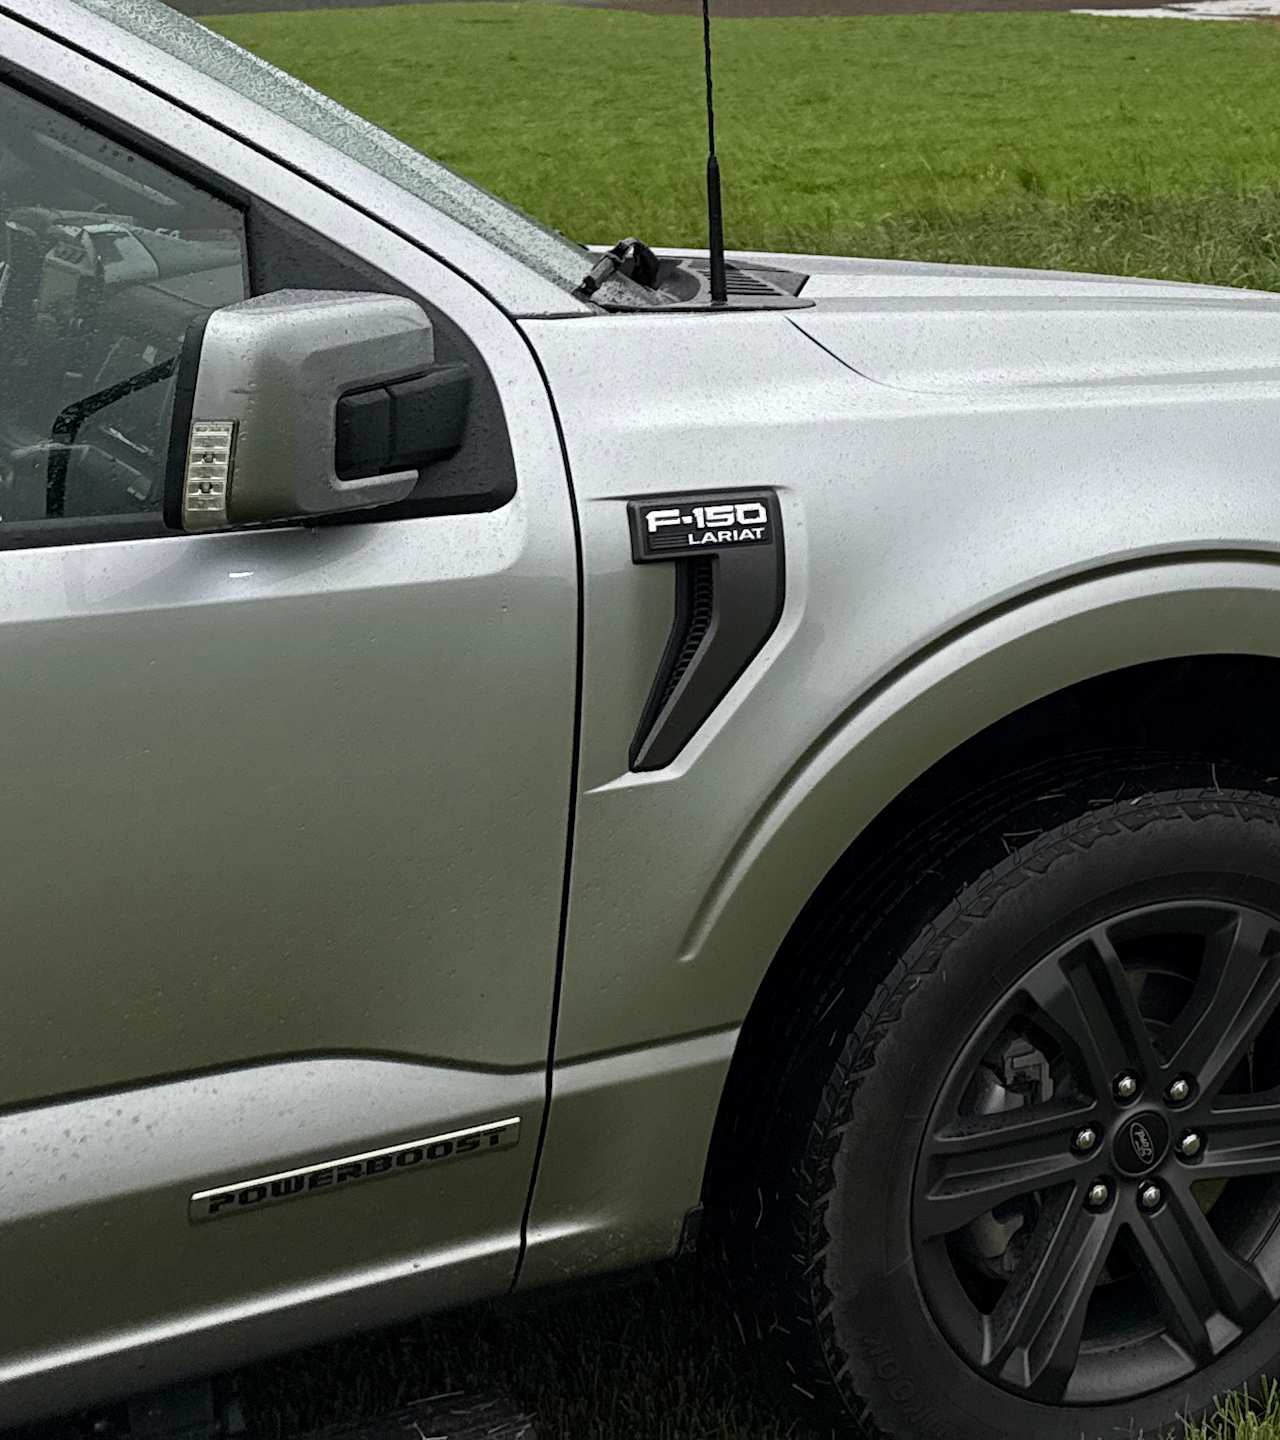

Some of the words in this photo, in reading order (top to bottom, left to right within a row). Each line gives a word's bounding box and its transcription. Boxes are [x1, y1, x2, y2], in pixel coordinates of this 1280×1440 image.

[645, 502, 768, 533] F-150
[688, 527, 766, 545] LARIAT
[207, 1126, 507, 1215] POWERBOOST
